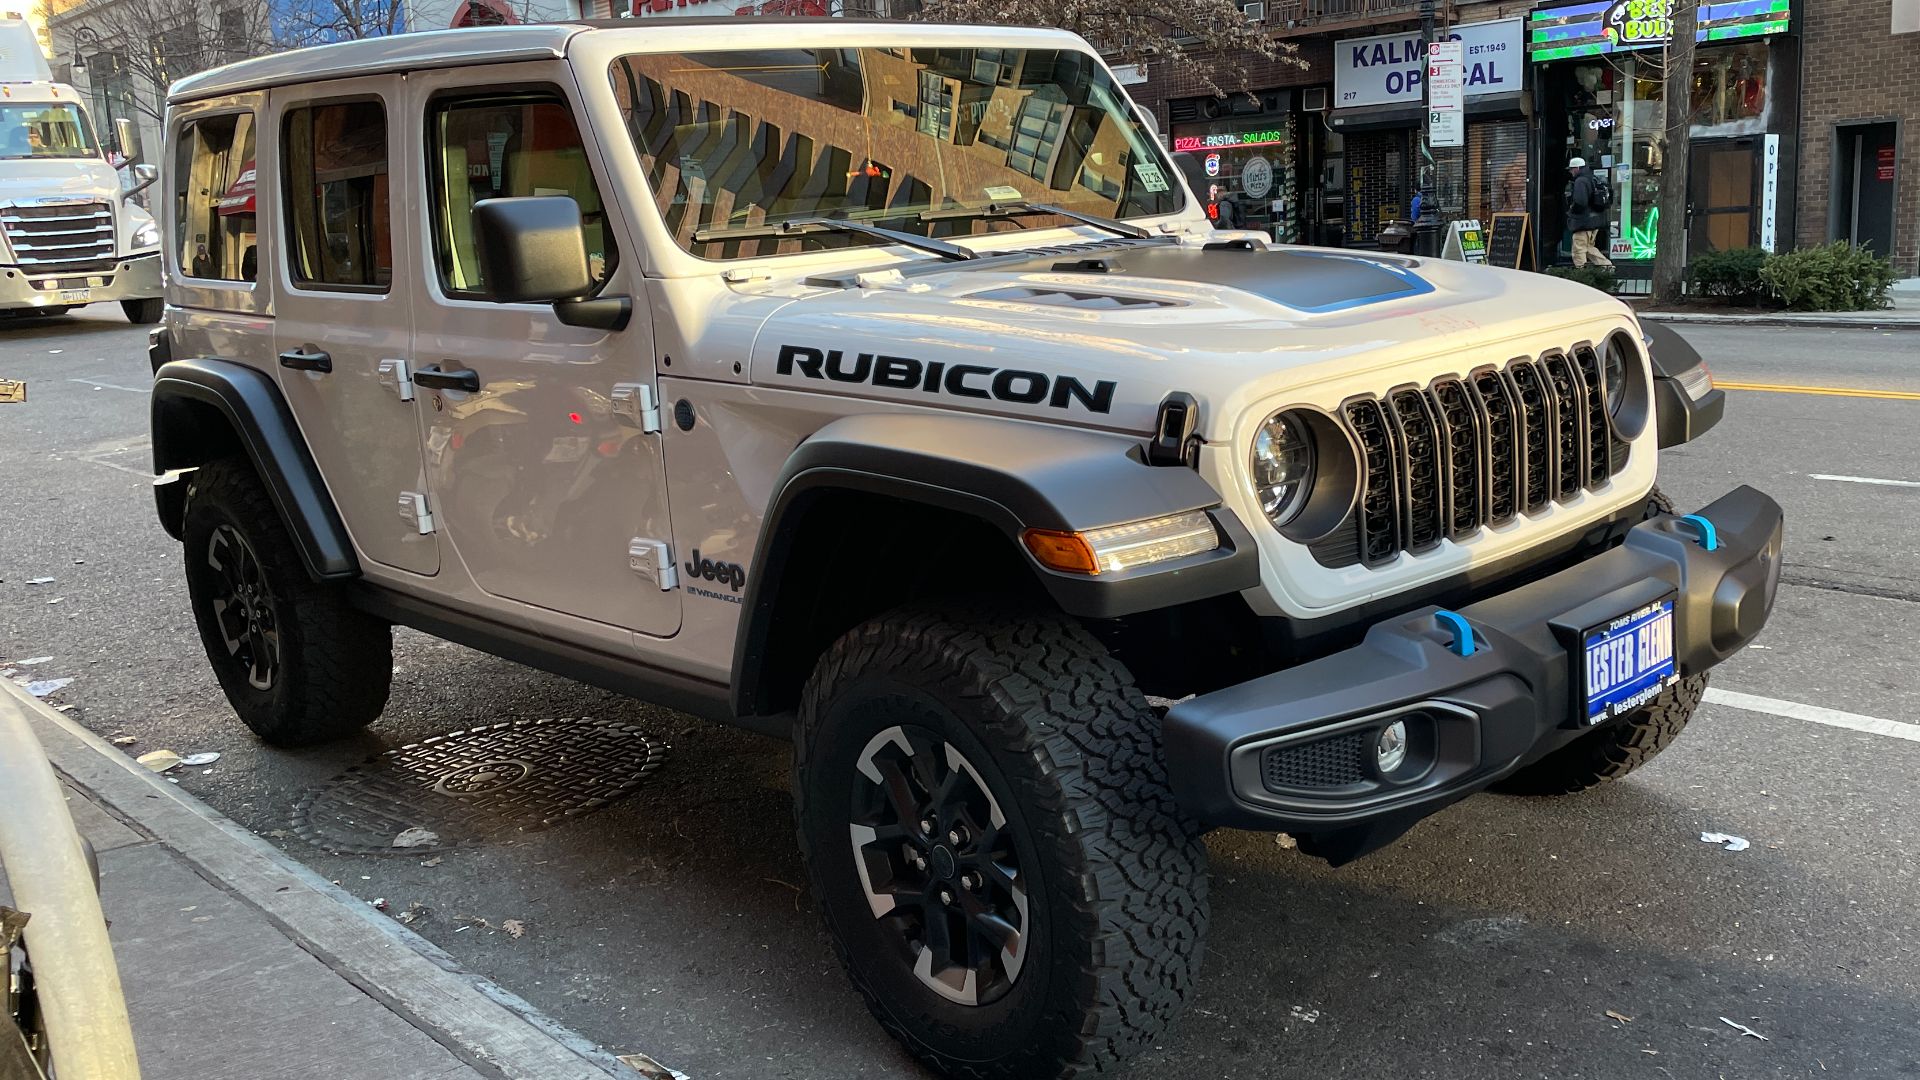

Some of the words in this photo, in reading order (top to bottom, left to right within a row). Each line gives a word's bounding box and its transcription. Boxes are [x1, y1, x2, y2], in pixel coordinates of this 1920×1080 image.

[1627, 0, 1675, 19] BES
[1625, 20, 1674, 40] BUD
[1352, 34, 1462, 68] KALM
[1469, 43, 1506, 55] EST.1949
[1385, 61, 1504, 95] OPAL
[1432, 67, 1439, 76] 3
[1343, 92, 1357, 100] 217
[1432, 113, 1439, 122] 2
[1175, 138, 1200, 150] PIZZA
[1206, 135, 1235, 147] PASTA
[1243, 131, 1280, 144] SALADS
[1765, 144, 1775, 247] OPTICA
[1612, 244, 1632, 252] ATM
[776, 344, 1117, 414] RUBICON
[685, 549, 745, 592] Jeep
[696, 588, 744, 604] WRANGLE
[1610, 615, 1630, 631] TOMS
[1586, 633, 1634, 697] LESTER
[1638, 613, 1672, 673] GLENN
